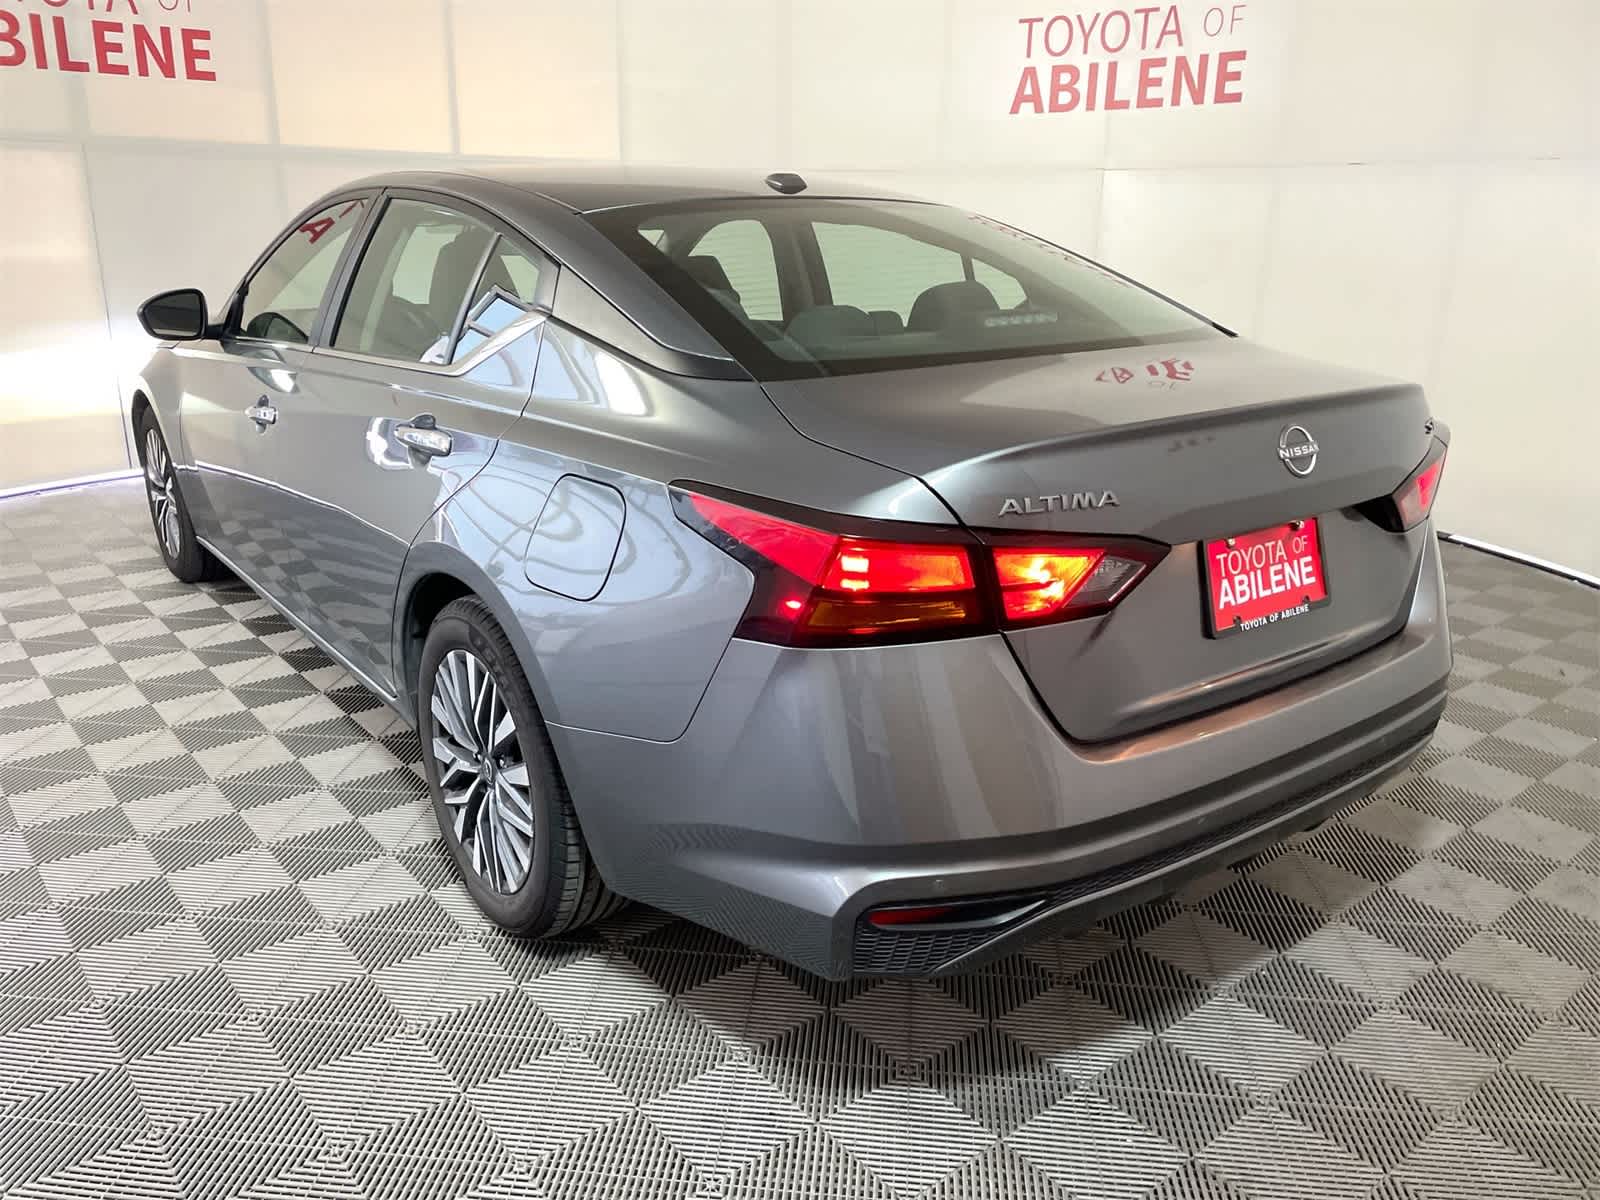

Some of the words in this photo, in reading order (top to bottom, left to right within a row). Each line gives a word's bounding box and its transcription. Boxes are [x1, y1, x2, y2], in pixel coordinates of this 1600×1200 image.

[0, 9, 217, 82] BILENE
[1018, 5, 1183, 58] TOYOTA
[1203, 4, 1247, 37] OF
[1009, 50, 1247, 115] ABILENE
[998, 489, 1120, 518] ALTIMA
[1216, 539, 1288, 577] TOYOTA
[1292, 535, 1308, 554] OF
[1218, 556, 1316, 610] ABILENE
[1240, 617, 1268, 632] TOYOTA
[1269, 612, 1279, 623] OF
[1281, 603, 1309, 619] ABILENE
